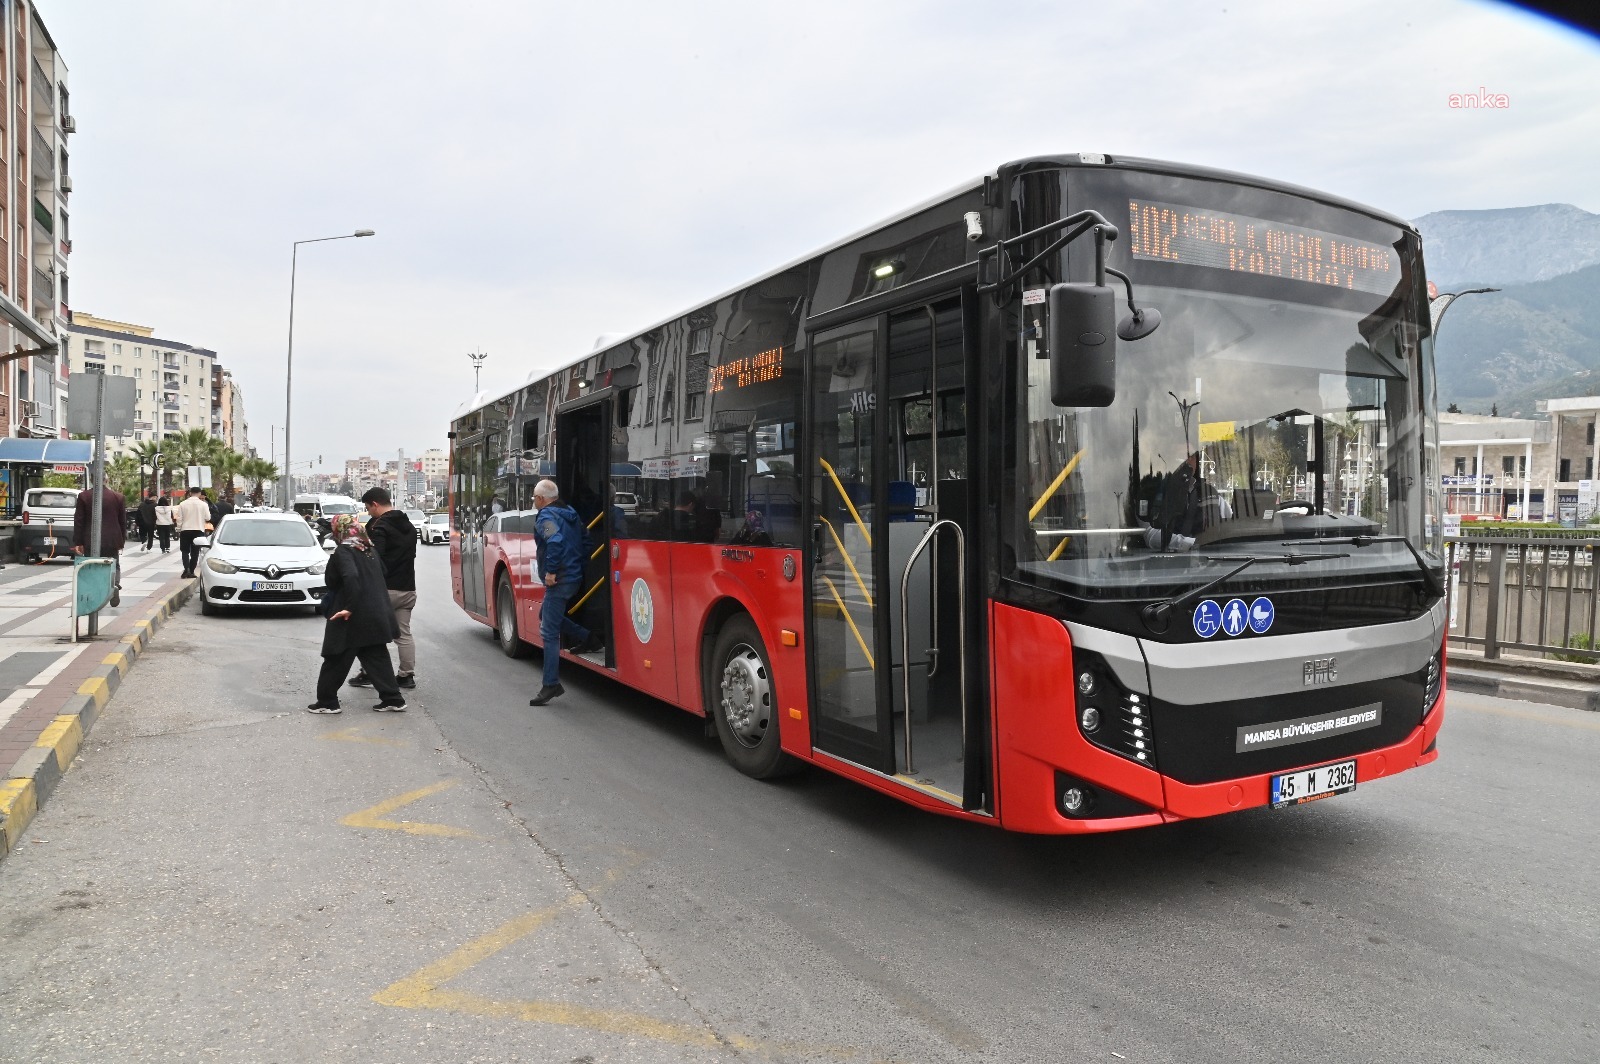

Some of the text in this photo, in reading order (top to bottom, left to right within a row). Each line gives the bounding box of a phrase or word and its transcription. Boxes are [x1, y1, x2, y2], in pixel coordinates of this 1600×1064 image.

[1282, 717, 1335, 739] BÜYÜKŞEHİR
[1280, 764, 1355, 799] 45 M 2362
